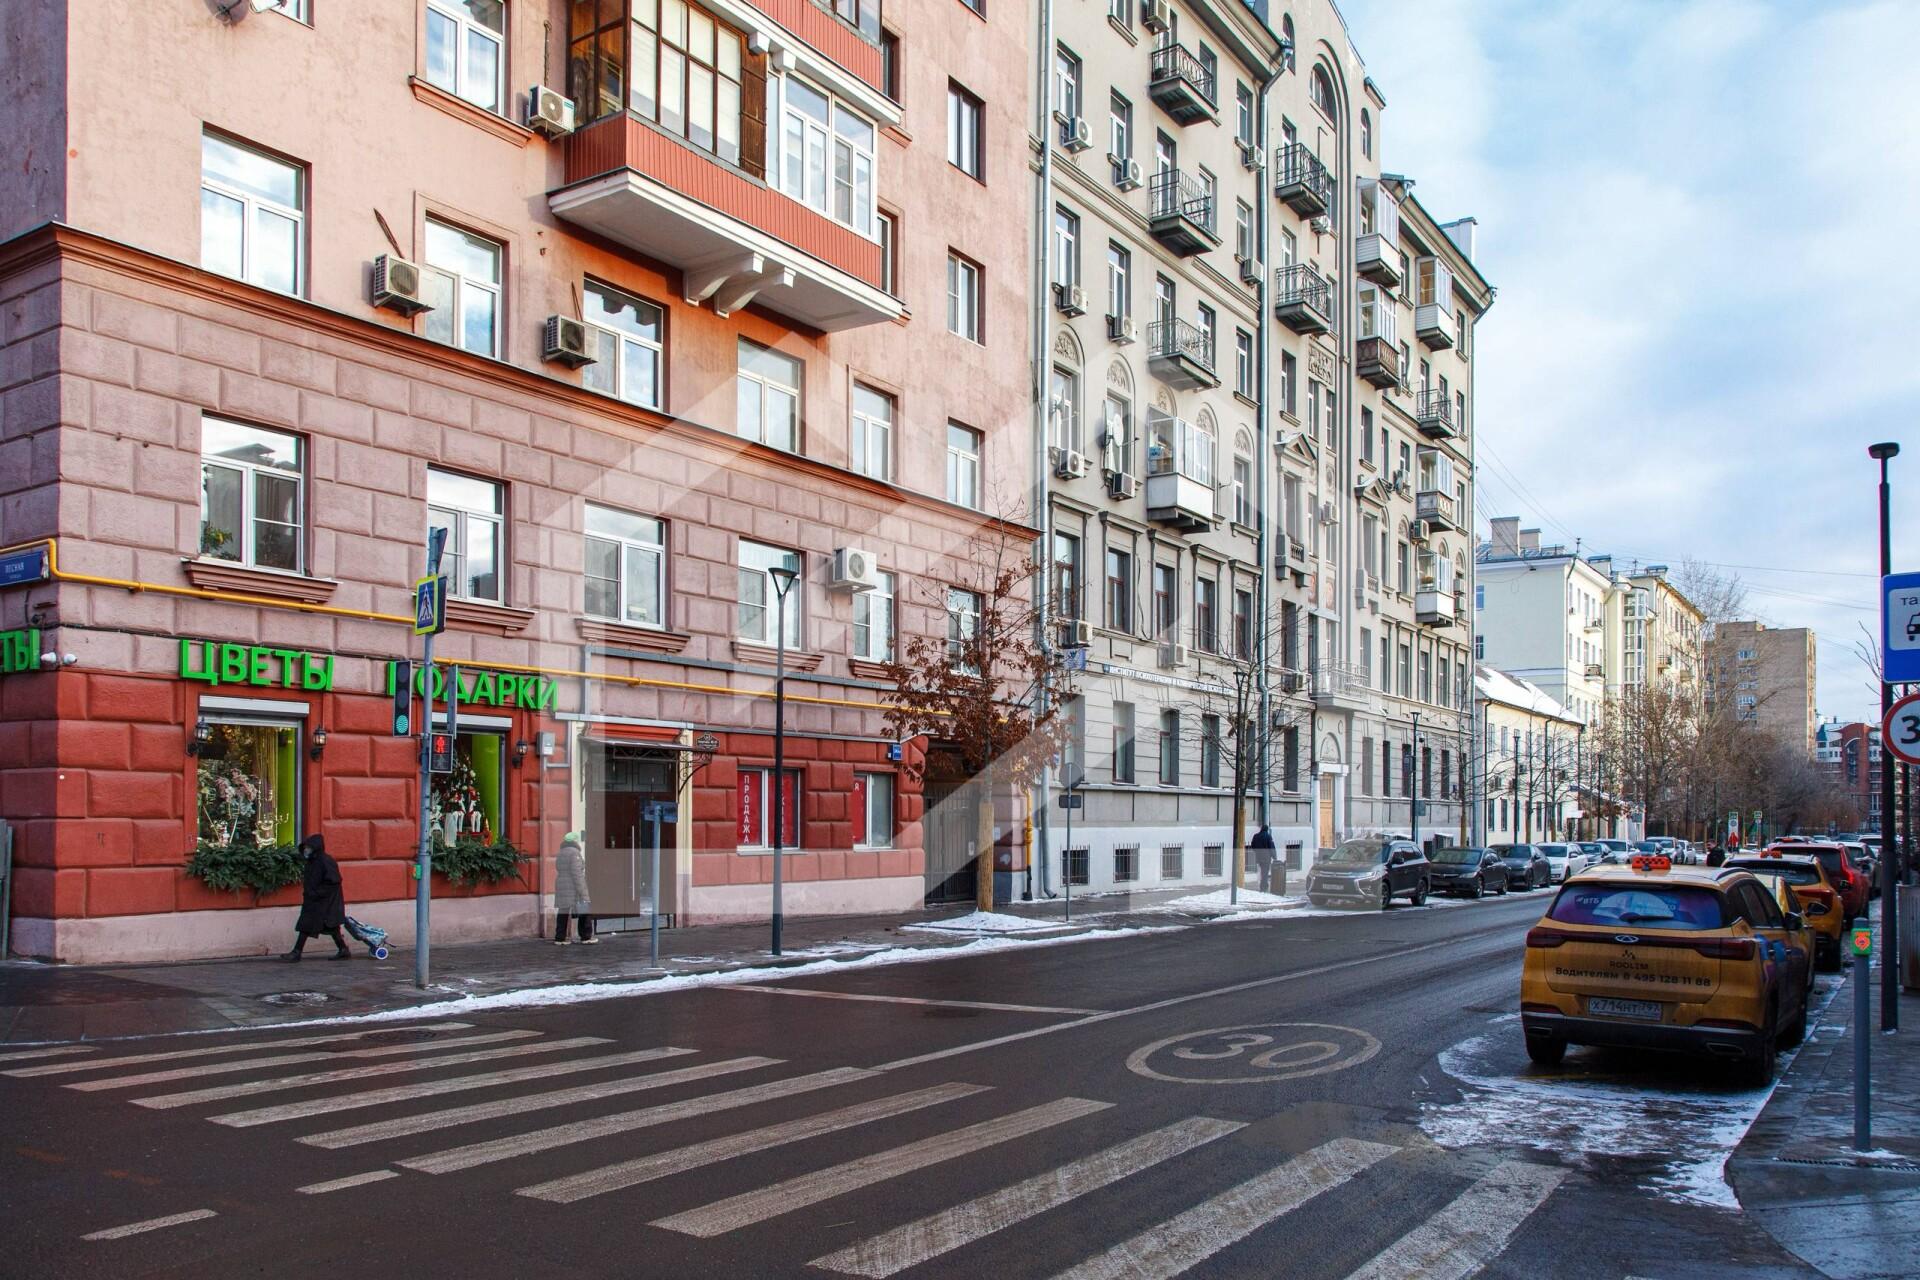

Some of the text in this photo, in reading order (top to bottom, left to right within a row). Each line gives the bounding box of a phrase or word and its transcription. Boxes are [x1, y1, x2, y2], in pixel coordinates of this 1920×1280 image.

[180, 639, 334, 692] ЦВЕТЫ
[742, 775, 751, 844] ПРОДАЖА
[1555, 967, 1618, 979] Водителям
[1634, 973, 1655, 983] 495
[1682, 976, 1691, 985] 11
[1172, 1033, 1341, 1068] 30
